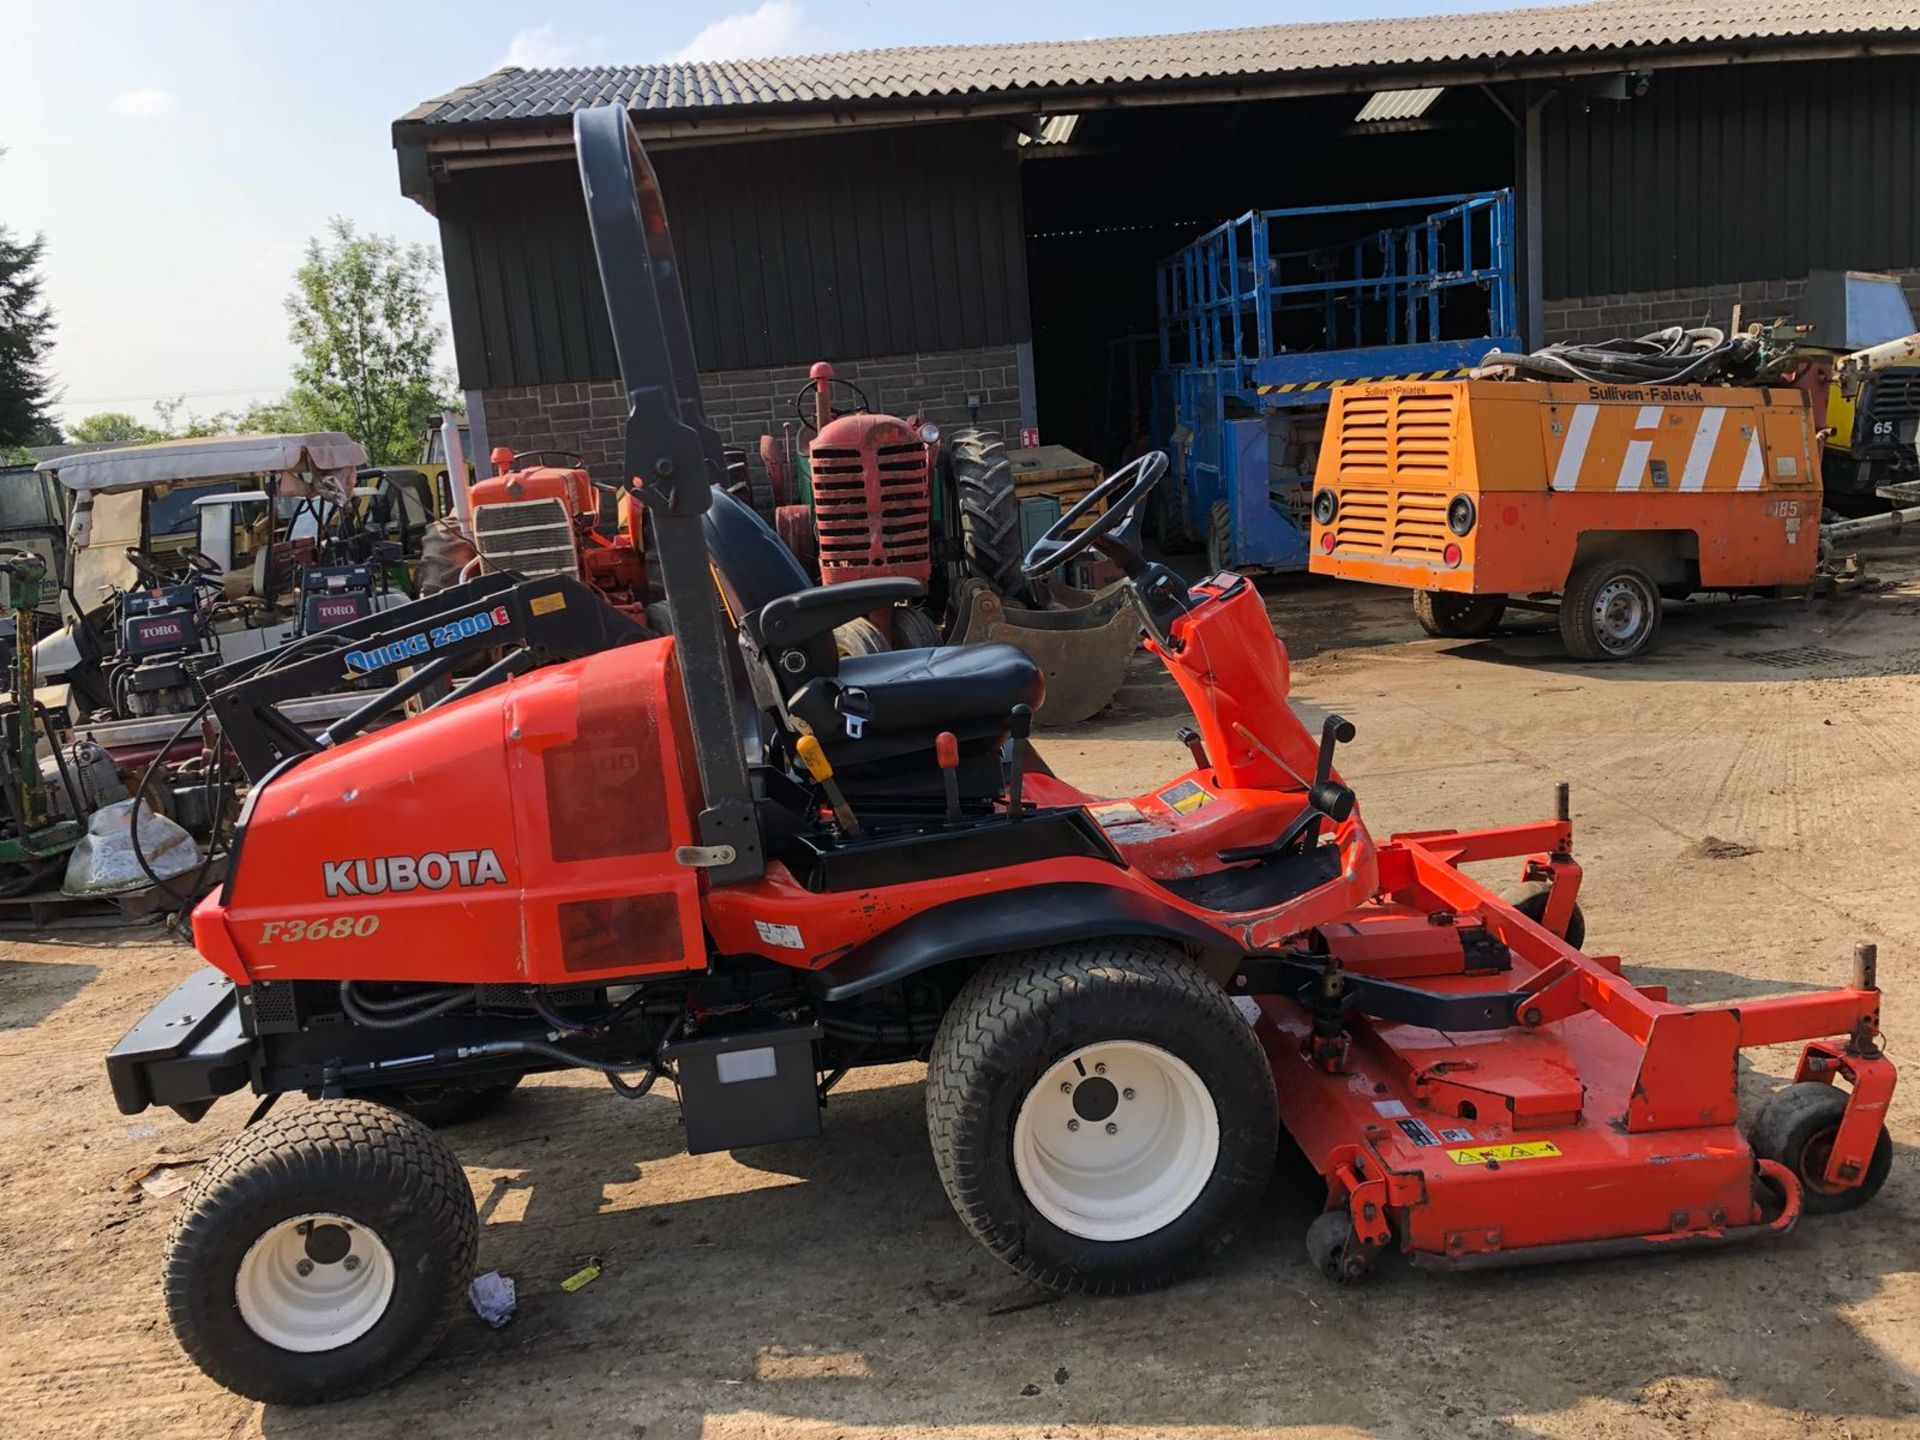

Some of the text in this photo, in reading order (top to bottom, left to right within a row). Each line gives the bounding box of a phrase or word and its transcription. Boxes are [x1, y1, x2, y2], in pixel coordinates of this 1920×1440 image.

[1873, 421, 1893, 435] 65
[1775, 501, 1799, 517] 185
[318, 604, 356, 618] TORO
[141, 624, 180, 638] TORO
[323, 848, 507, 897] KUBOTA
[259, 914, 380, 944] F3680
